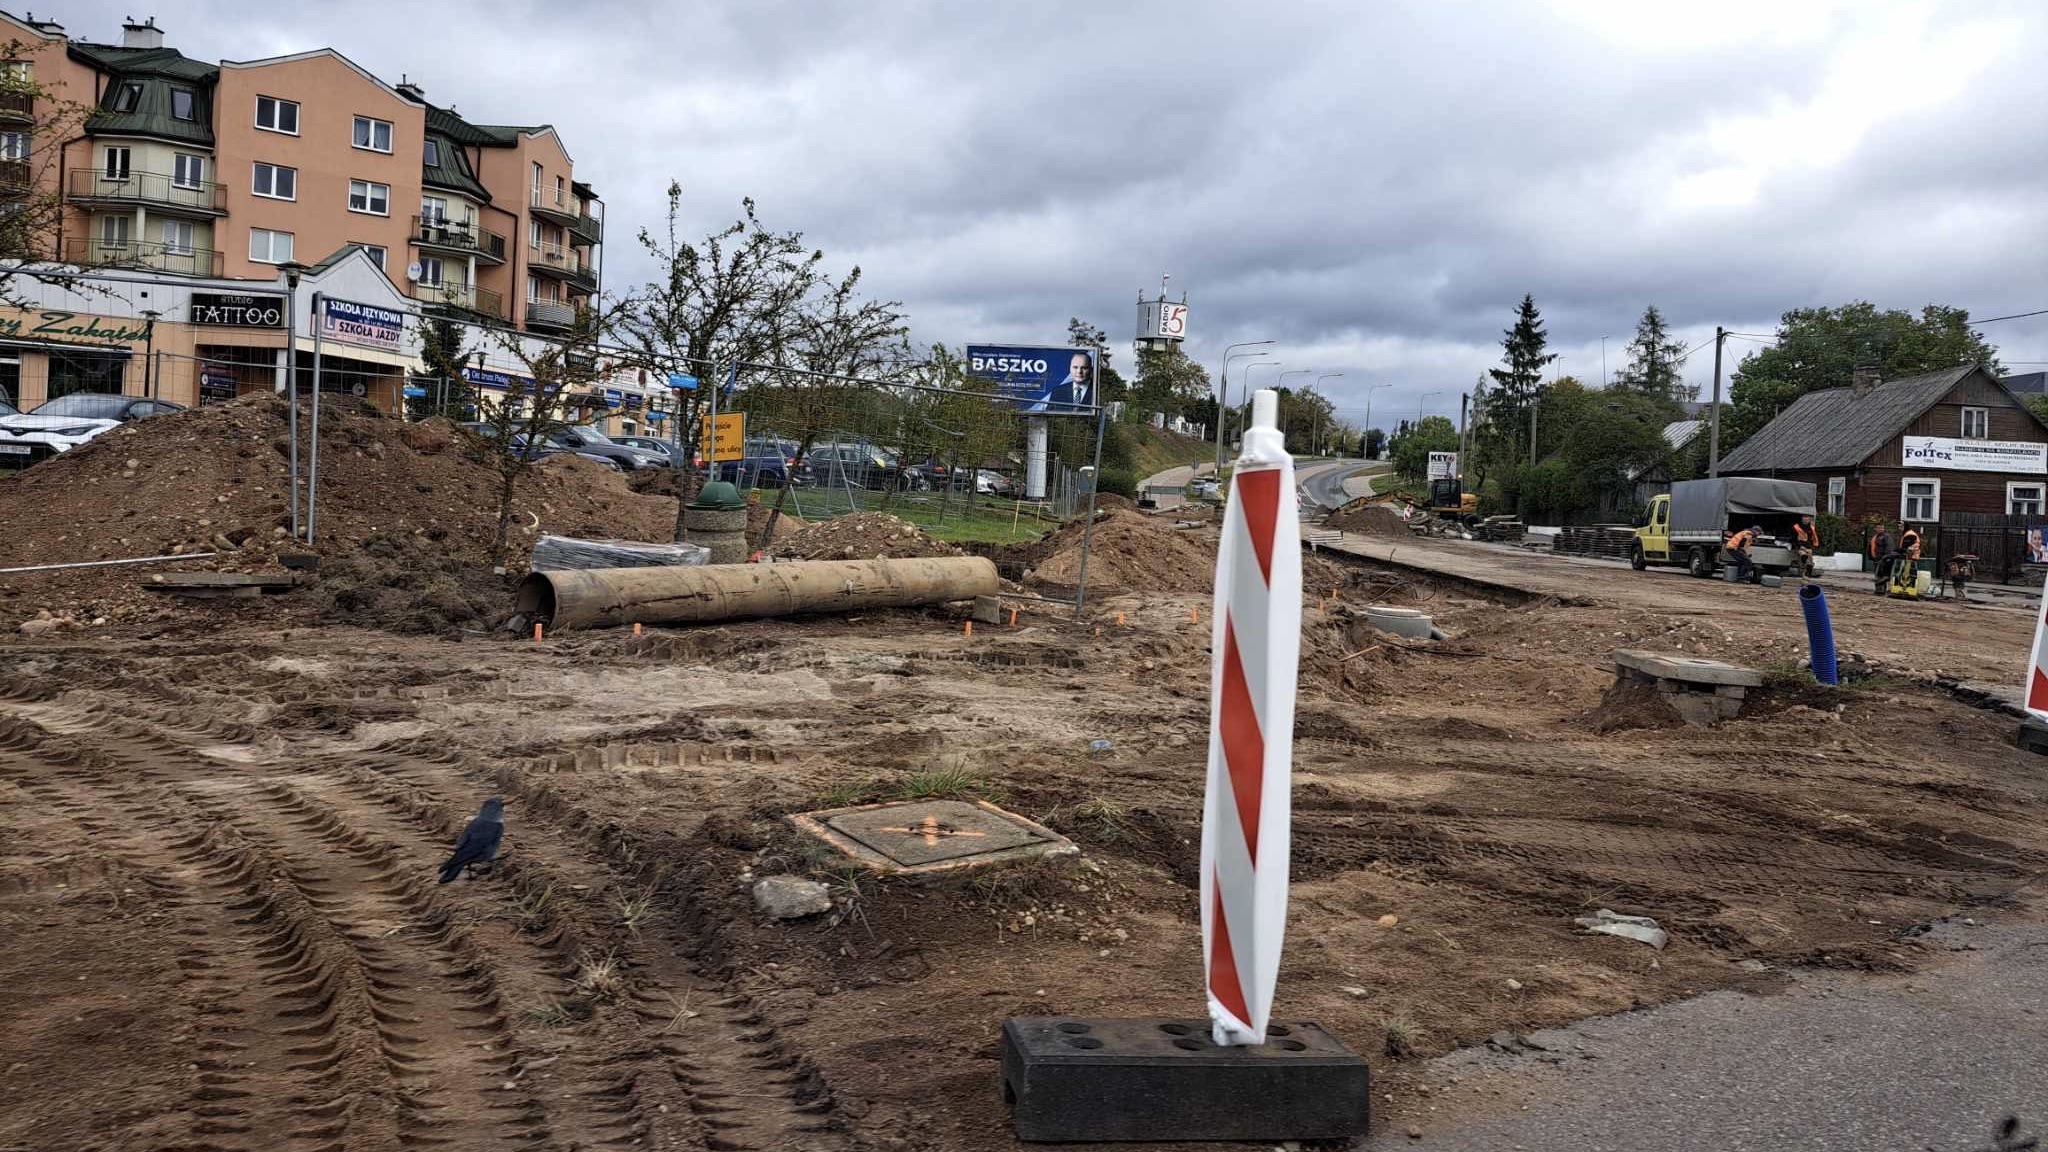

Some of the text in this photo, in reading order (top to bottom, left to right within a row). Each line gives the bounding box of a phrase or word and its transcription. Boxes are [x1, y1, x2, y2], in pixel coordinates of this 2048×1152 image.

[221, 295, 253, 304] STUDIO
[192, 305, 280, 325] TATTOO
[330, 300, 401, 324] SZKOŁA JĘZYKOWA
[1162, 305, 1170, 332] RADIO
[1168, 307, 1187, 333] 5
[338, 321, 373, 338] SZKOŁA
[375, 331, 400, 343] JAZDY
[972, 358, 1048, 373] BASZKO
[1905, 448, 1952, 460] FolTex
